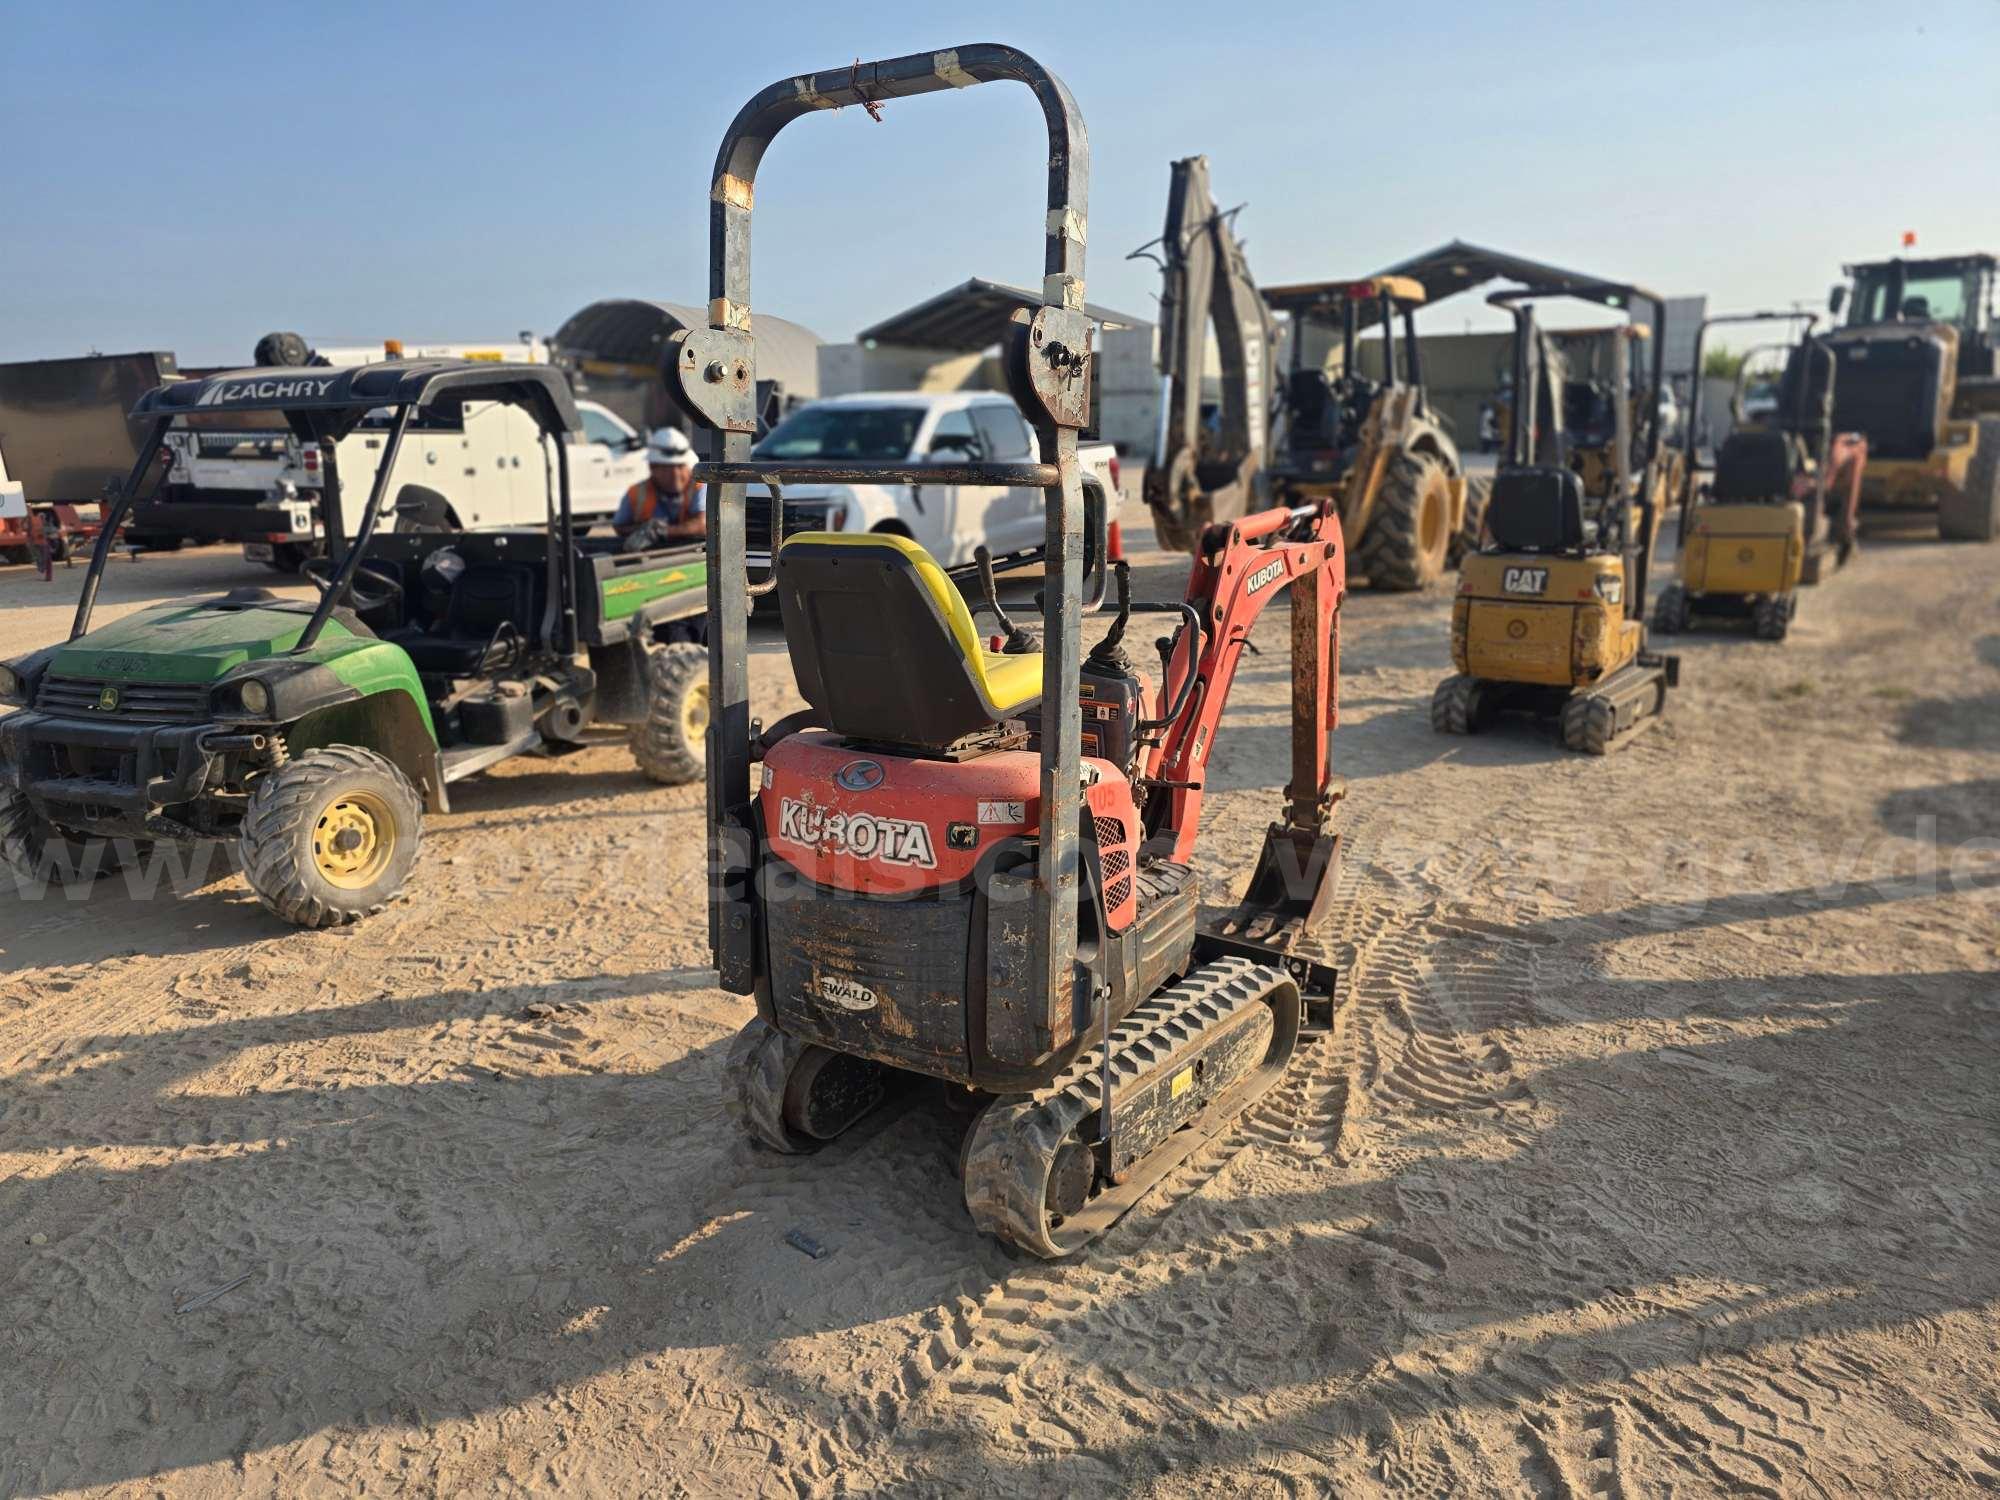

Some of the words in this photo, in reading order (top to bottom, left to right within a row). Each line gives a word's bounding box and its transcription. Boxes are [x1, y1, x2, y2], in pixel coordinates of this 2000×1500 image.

[223, 380, 336, 401] ZACHRY
[1247, 558, 1284, 596] KUBOTA
[1504, 568, 1547, 593] CAT
[780, 797, 937, 868] KUBOTA
